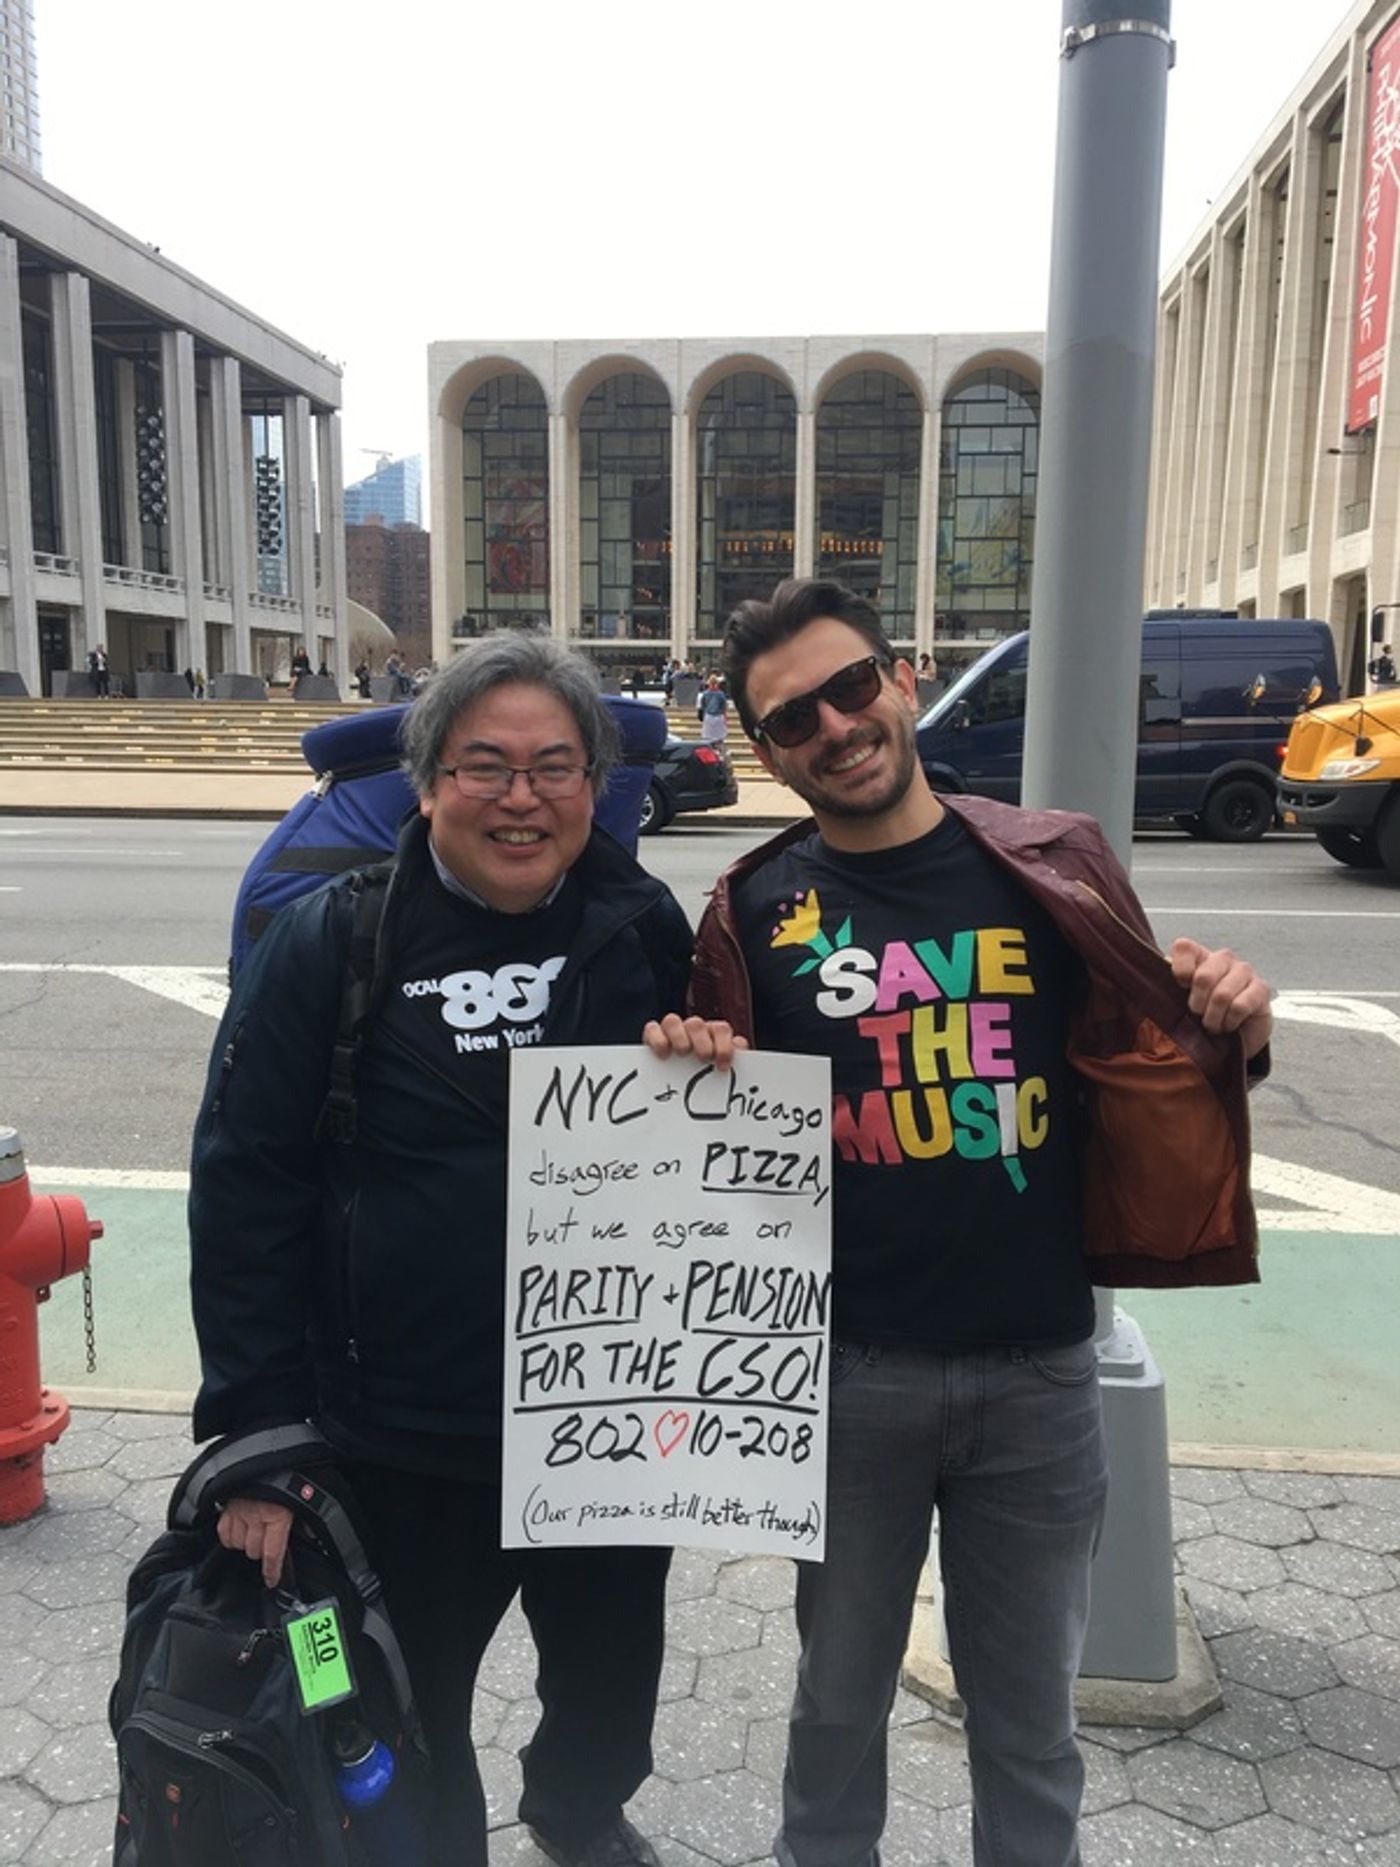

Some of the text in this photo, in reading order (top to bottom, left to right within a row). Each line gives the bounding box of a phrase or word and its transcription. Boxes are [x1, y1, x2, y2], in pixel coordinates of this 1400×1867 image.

[402, 979, 440, 997] OCAL
[816, 928, 1035, 1018] SAVE
[455, 1033, 499, 1053] New
[857, 1002, 1016, 1087] THE
[534, 1064, 648, 1131] NYC
[684, 1064, 823, 1137] Chicago
[832, 1076, 1049, 1165] MUSIC
[529, 1149, 638, 1196] disagree
[653, 1158, 681, 1177] on
[527, 1207, 793, 1249] but we agree on
[515, 1264, 654, 1334] PARITY
[681, 1260, 832, 1331] PENSION
[520, 1337, 824, 1402] FOR THE CSO!
[544, 1410, 814, 1468] 802 10-208
[577, 1501, 632, 1527] pizza
[640, 1501, 655, 1519] is
[660, 1492, 701, 1520] still
[701, 1498, 753, 1527] better
[313, 1617, 338, 1663] 310
